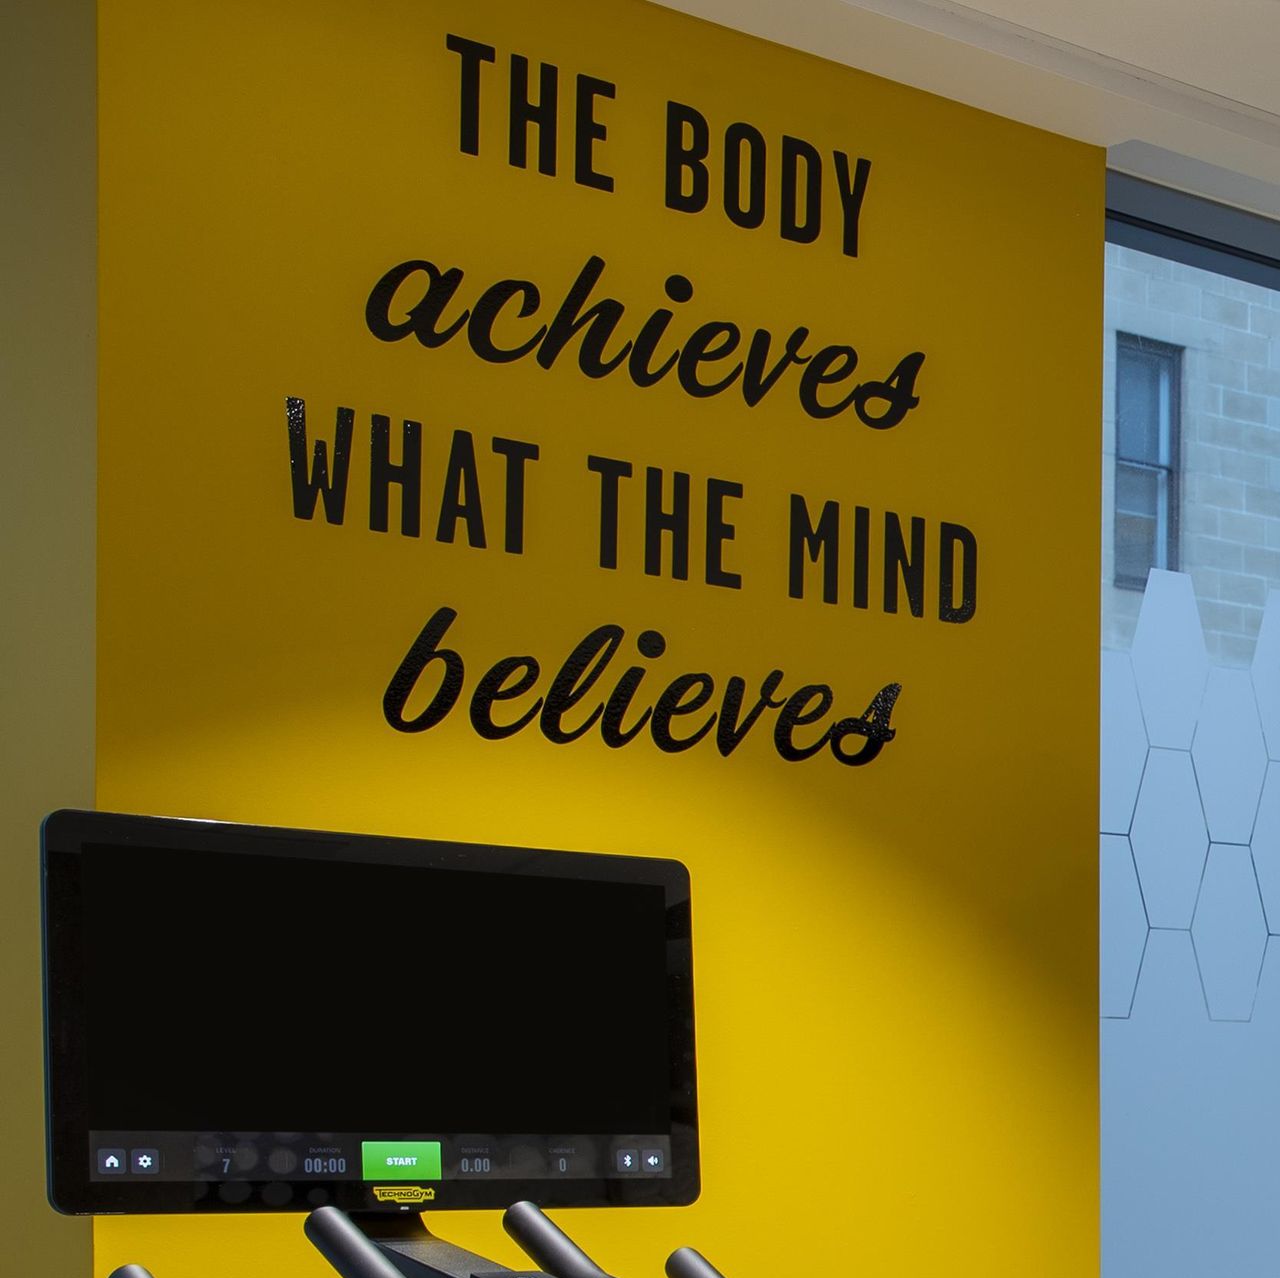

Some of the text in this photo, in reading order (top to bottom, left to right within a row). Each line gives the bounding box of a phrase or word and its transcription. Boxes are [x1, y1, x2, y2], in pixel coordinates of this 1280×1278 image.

[447, 34, 872, 258] THE BODY
[365, 255, 926, 430] achieves
[286, 397, 978, 624] WHAT THE MIND
[382, 606, 902, 767] believes
[222, 1158, 231, 1173] 7
[304, 1158, 346, 1173] 00:00
[386, 1157, 418, 1166] START
[461, 1158, 490, 1173] 0.00
[559, 1157, 567, 1173] 0
[375, 1188, 433, 1201] TECHNOGYM
